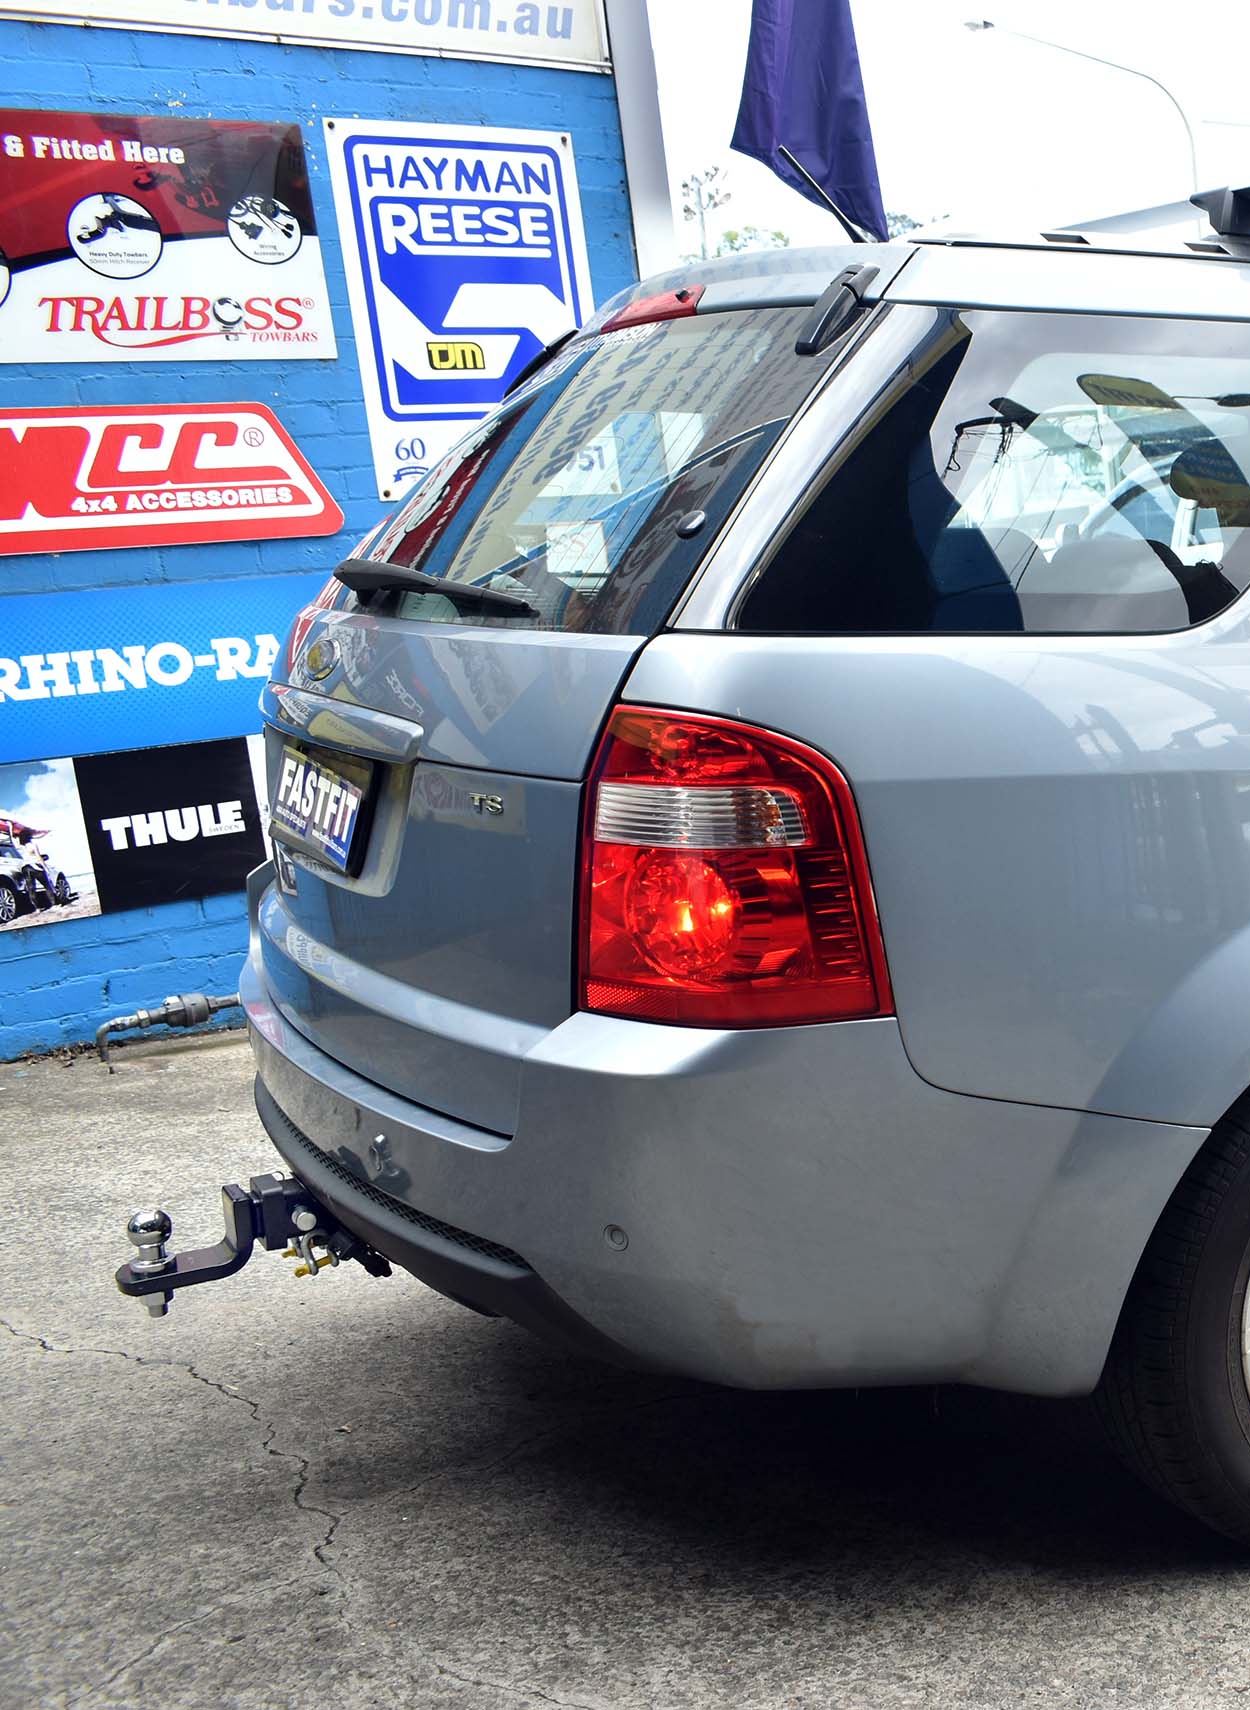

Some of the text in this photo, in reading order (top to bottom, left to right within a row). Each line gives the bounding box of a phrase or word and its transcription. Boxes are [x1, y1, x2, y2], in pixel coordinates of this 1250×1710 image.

[4, 135, 185, 164] & Fitted Here
[362, 154, 552, 196] HAYMAN
[377, 202, 552, 256] REESE
[250, 331, 318, 343] TOWBARS
[395, 437, 426, 461] 60
[71, 486, 293, 514] 4x4 ACCESSORIES
[278, 757, 359, 843] FASTFIT
[468, 792, 503, 815] TS
[100, 800, 246, 850] THULE
[208, 824, 240, 833] SWEDEN
